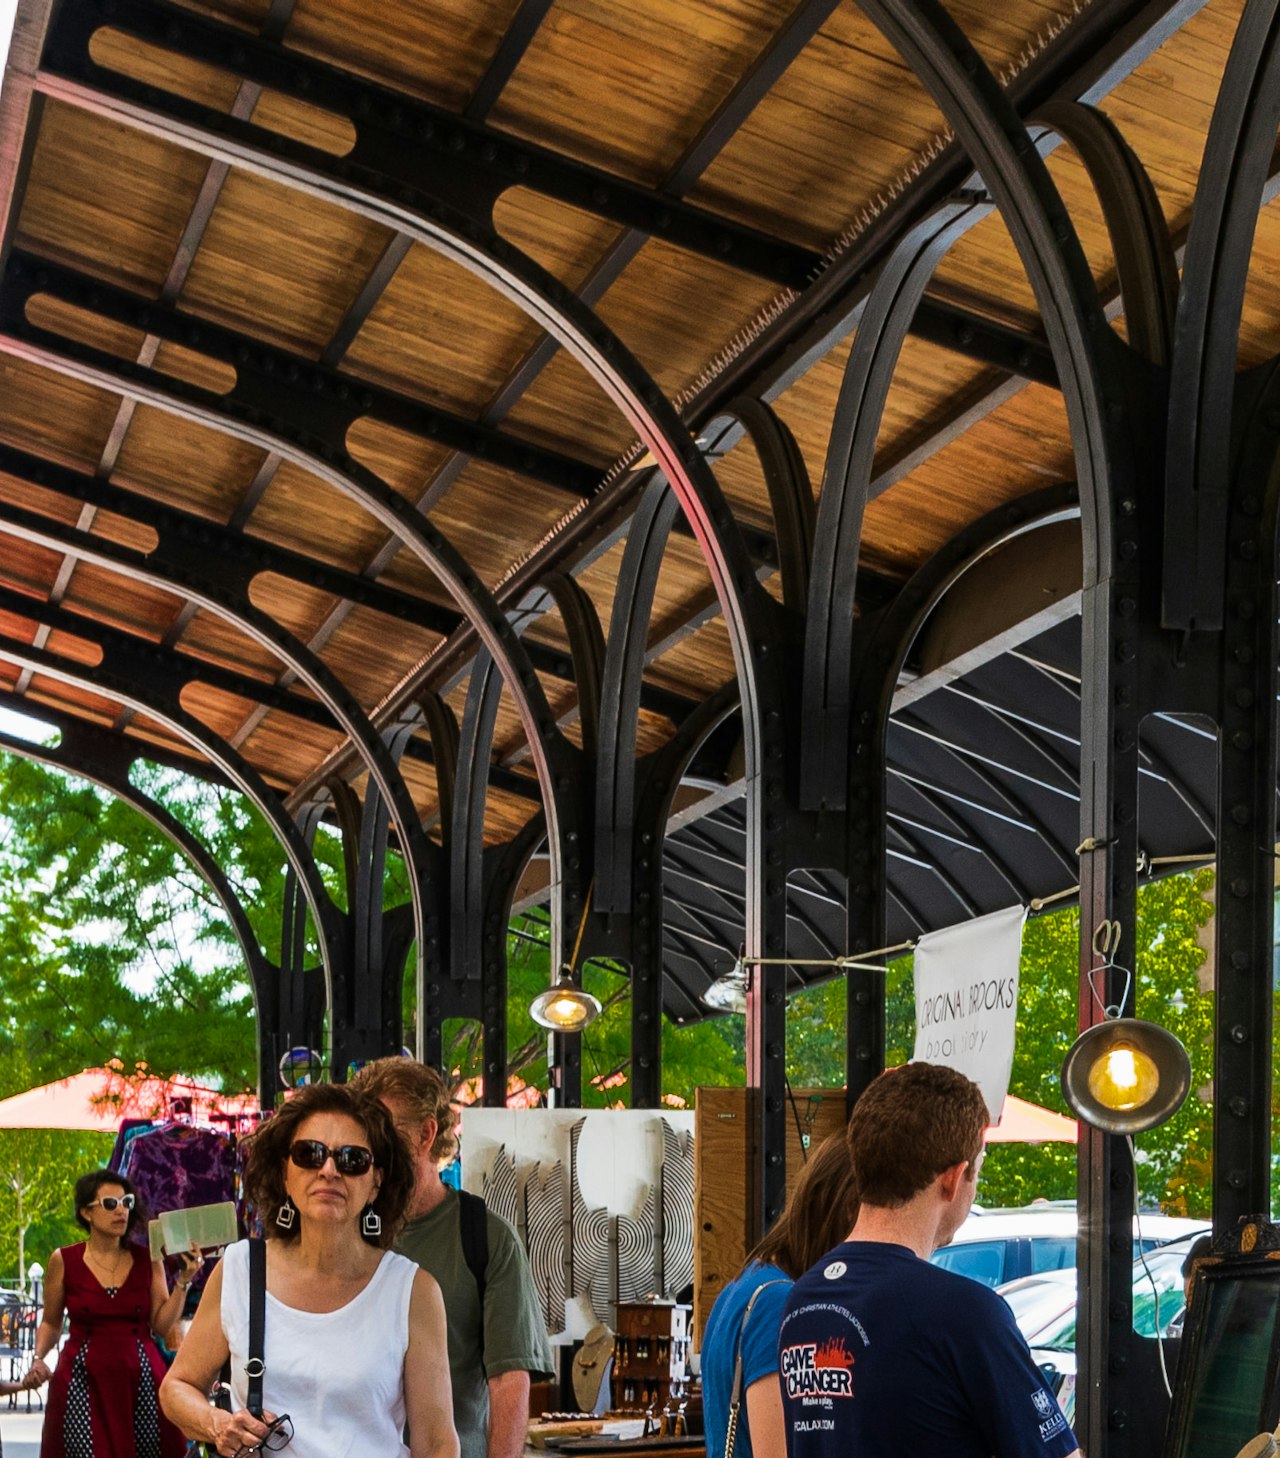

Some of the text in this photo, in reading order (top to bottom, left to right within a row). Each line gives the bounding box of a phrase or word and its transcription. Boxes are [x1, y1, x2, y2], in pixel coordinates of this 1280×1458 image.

[969, 977, 1014, 1016] BROOKS
[799, 1303, 827, 1315] CHRISTIAN
[827, 1303, 850, 1319] ATHLETES
[781, 1344, 816, 1376] GAME
[787, 1367, 852, 1398] CHANGER
[802, 1397, 818, 1406] Make
